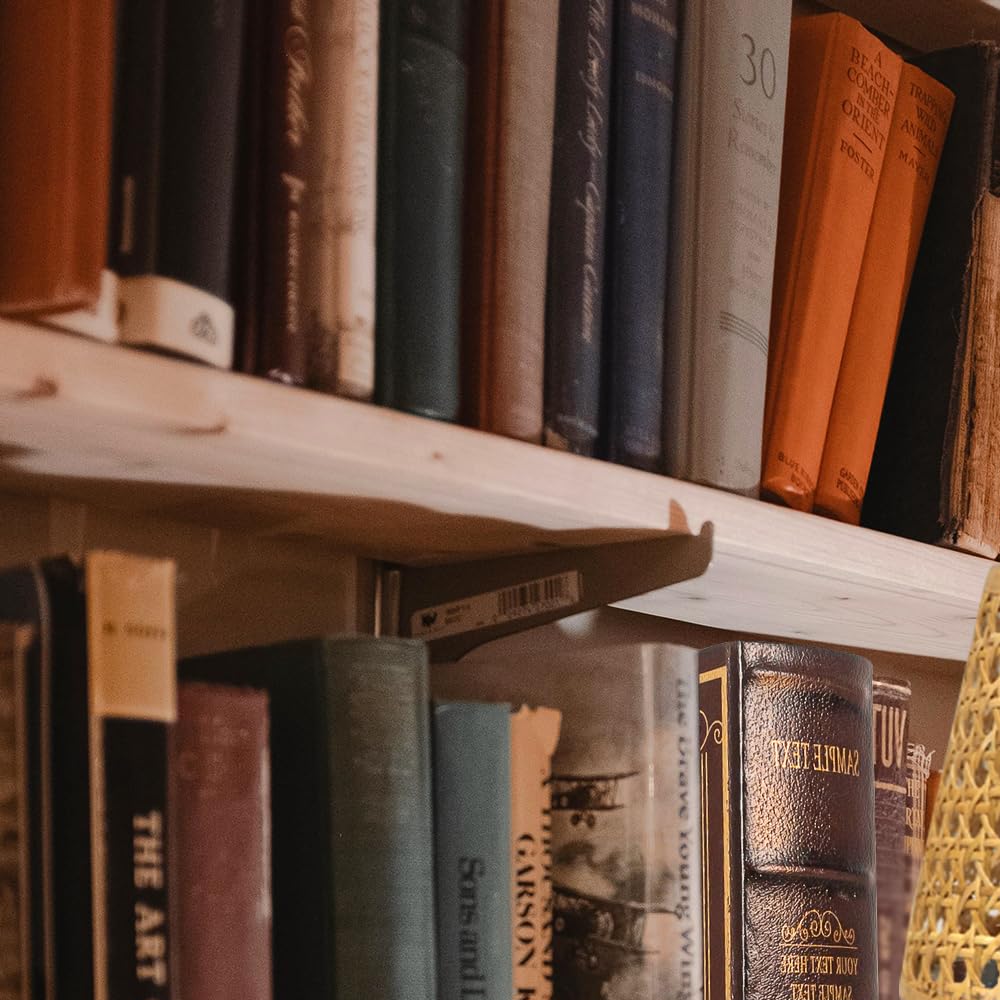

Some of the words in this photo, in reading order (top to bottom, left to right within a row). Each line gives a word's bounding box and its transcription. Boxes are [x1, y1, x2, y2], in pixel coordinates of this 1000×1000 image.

[738, 33, 777, 100] 30
[846, 66, 891, 118] COMBER
[873, 50, 883, 69] A
[841, 98, 887, 151] ORIENT
[839, 138, 876, 183] FOSTER
[132, 809, 164, 890] THE
[675, 829, 693, 920] Young
[458, 856, 486, 925] Sons
[515, 833, 536, 967] GARSON
[135, 900, 167, 987] ART
[459, 929, 487, 982] and
